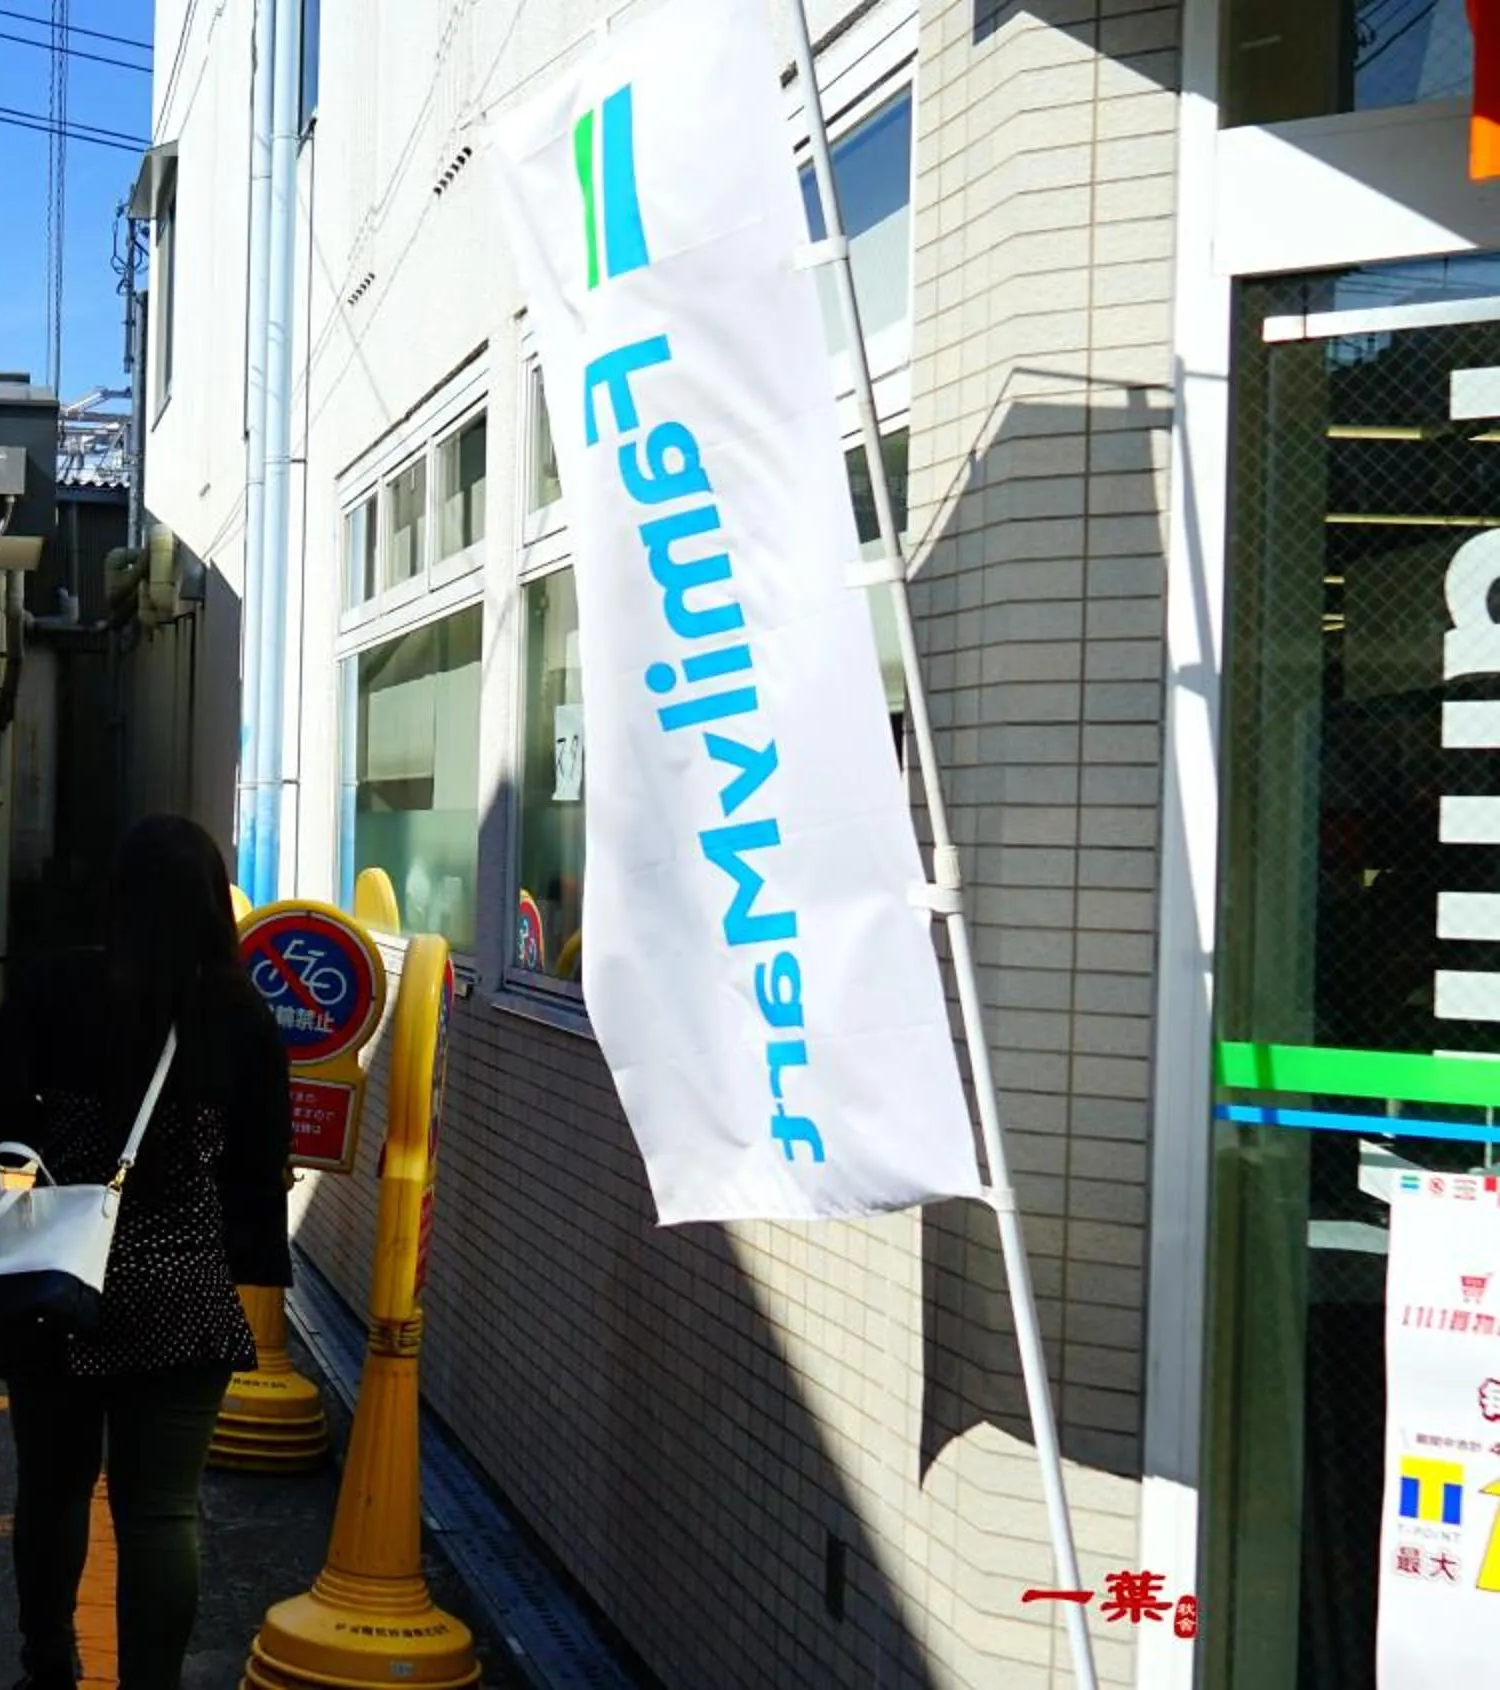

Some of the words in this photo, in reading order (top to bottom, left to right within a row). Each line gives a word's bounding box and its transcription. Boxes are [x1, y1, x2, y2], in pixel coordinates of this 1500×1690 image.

[268, 1003, 336, 1033] 輪禁止
[1395, 1546, 1458, 1581] 最大
